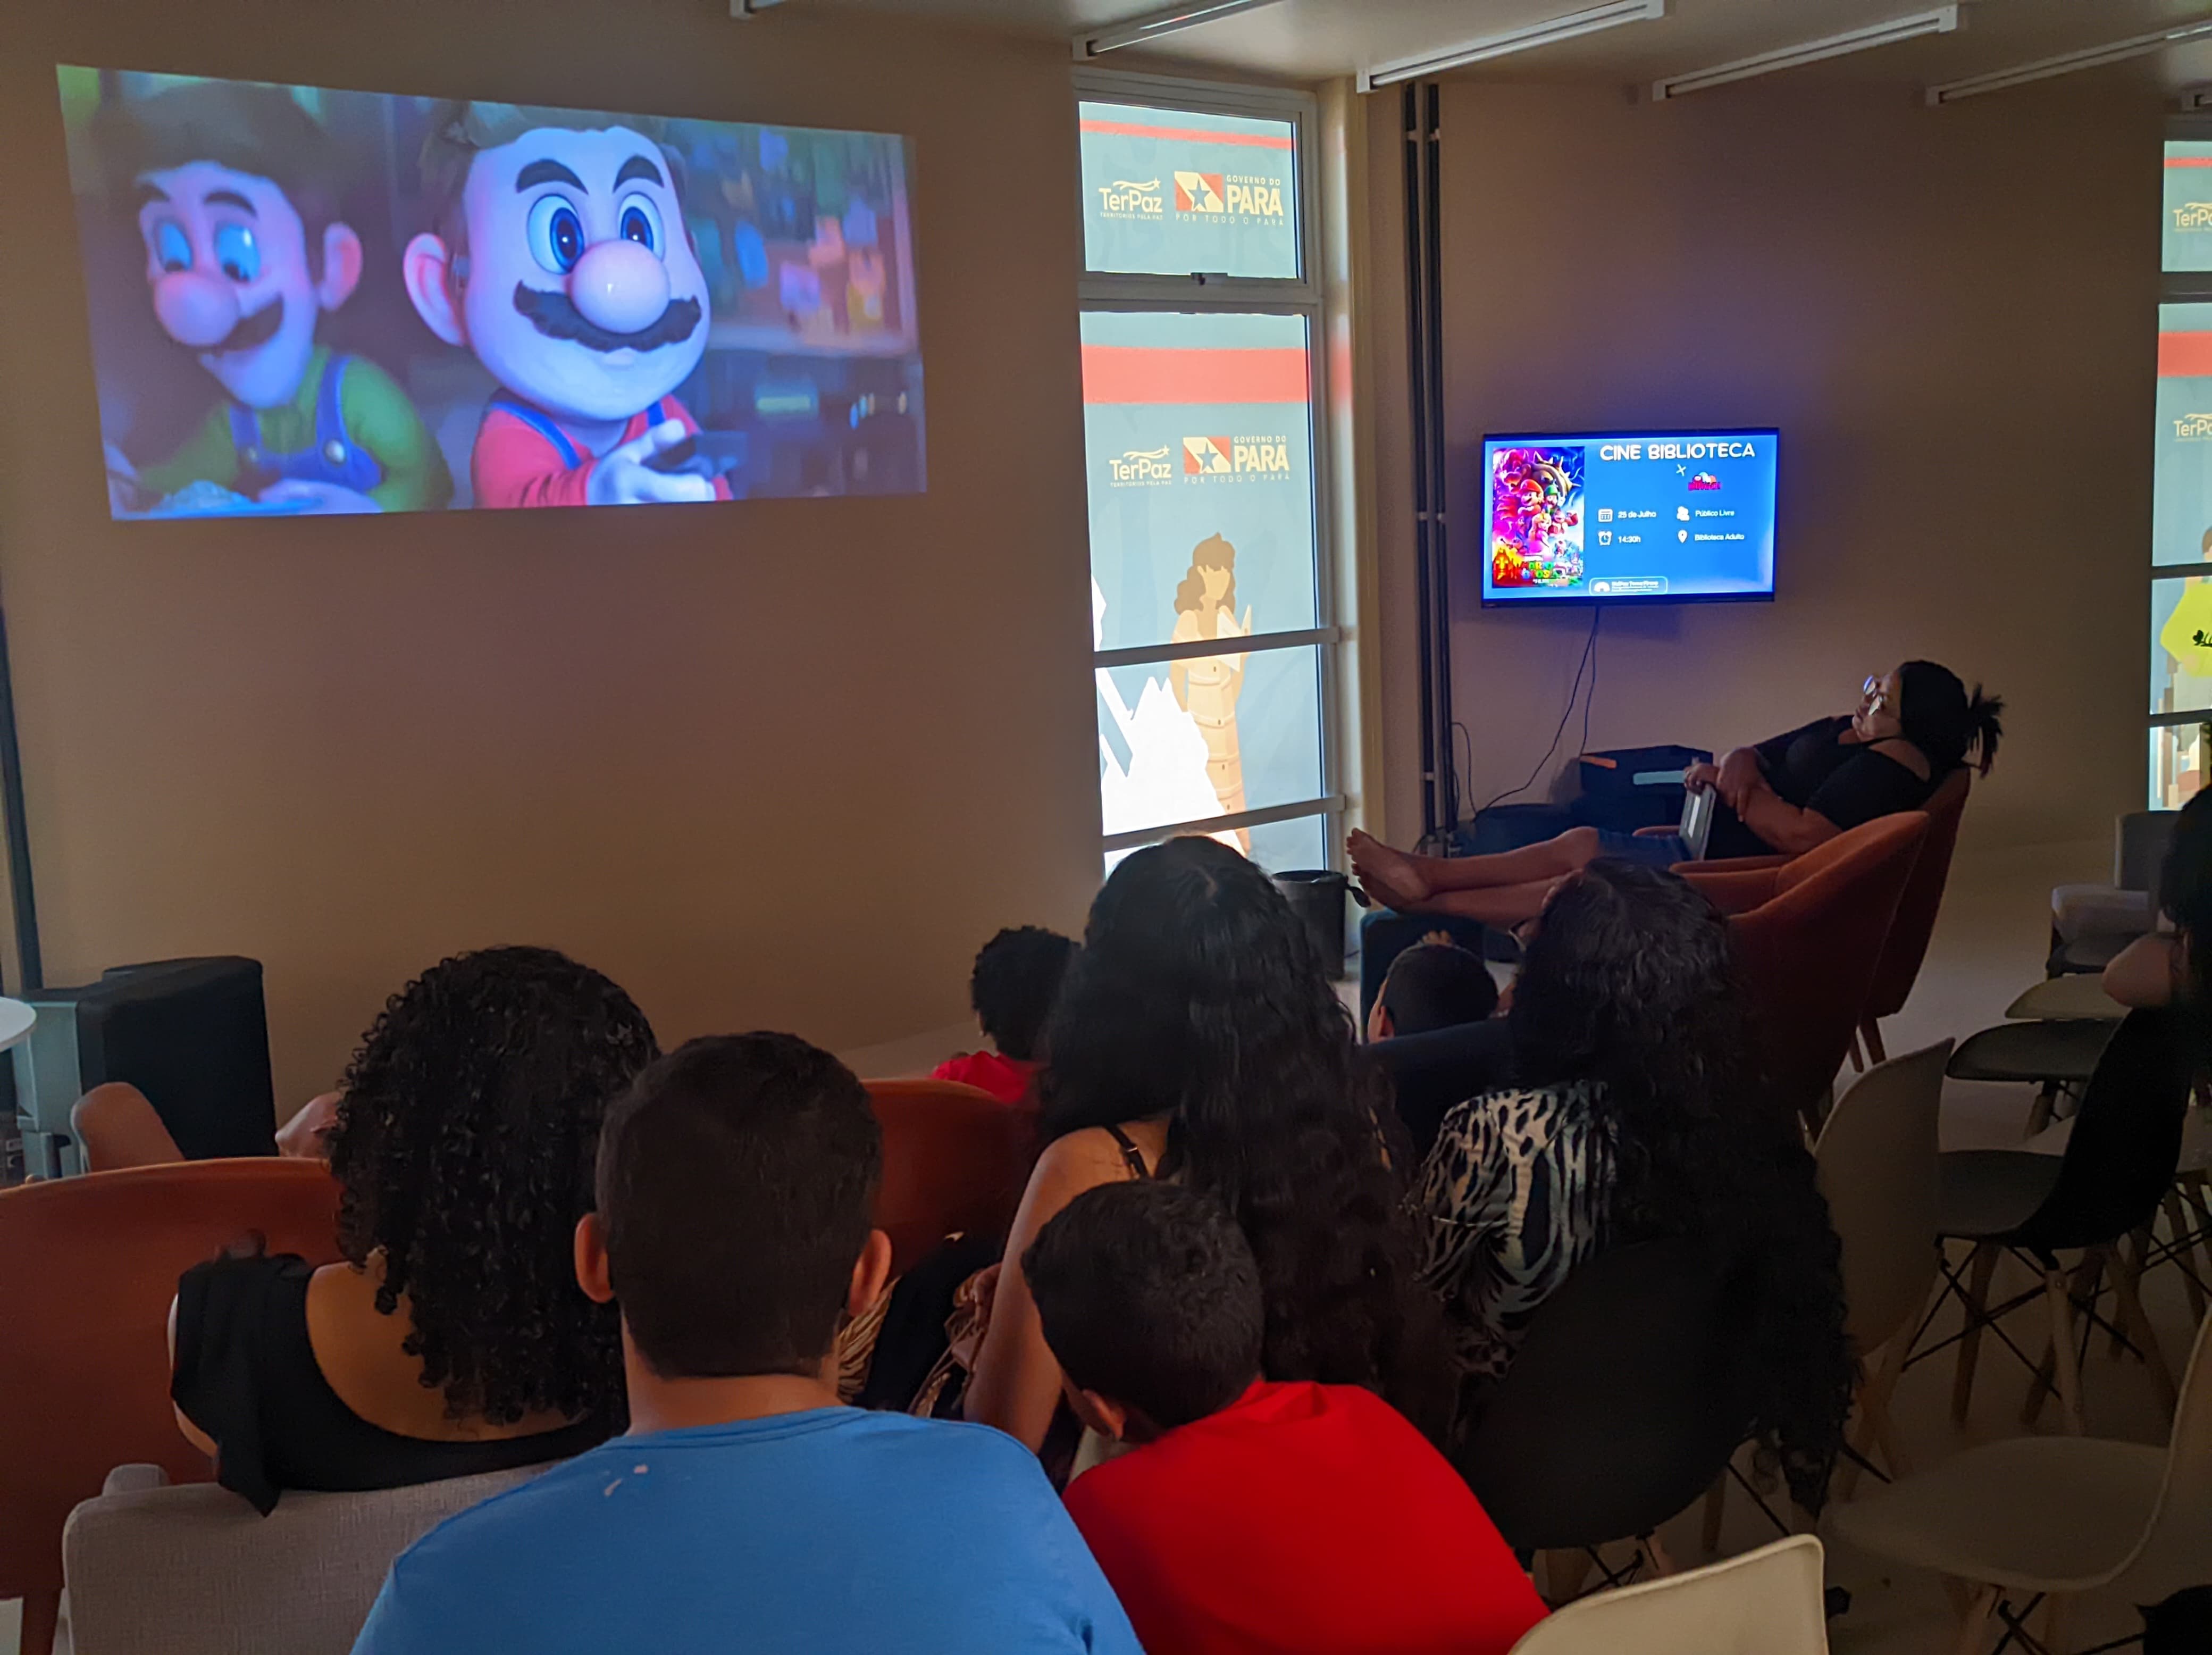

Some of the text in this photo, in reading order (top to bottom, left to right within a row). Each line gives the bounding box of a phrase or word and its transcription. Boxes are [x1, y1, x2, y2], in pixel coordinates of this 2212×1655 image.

[1226, 175, 1266, 185] GOVERNO
[1099, 188, 1162, 213] TerPaz
[1205, 215, 1235, 224] TODO
[1600, 442, 1756, 461] CINE BIBLIOTECA
[1109, 458, 1171, 480] TerPaz
